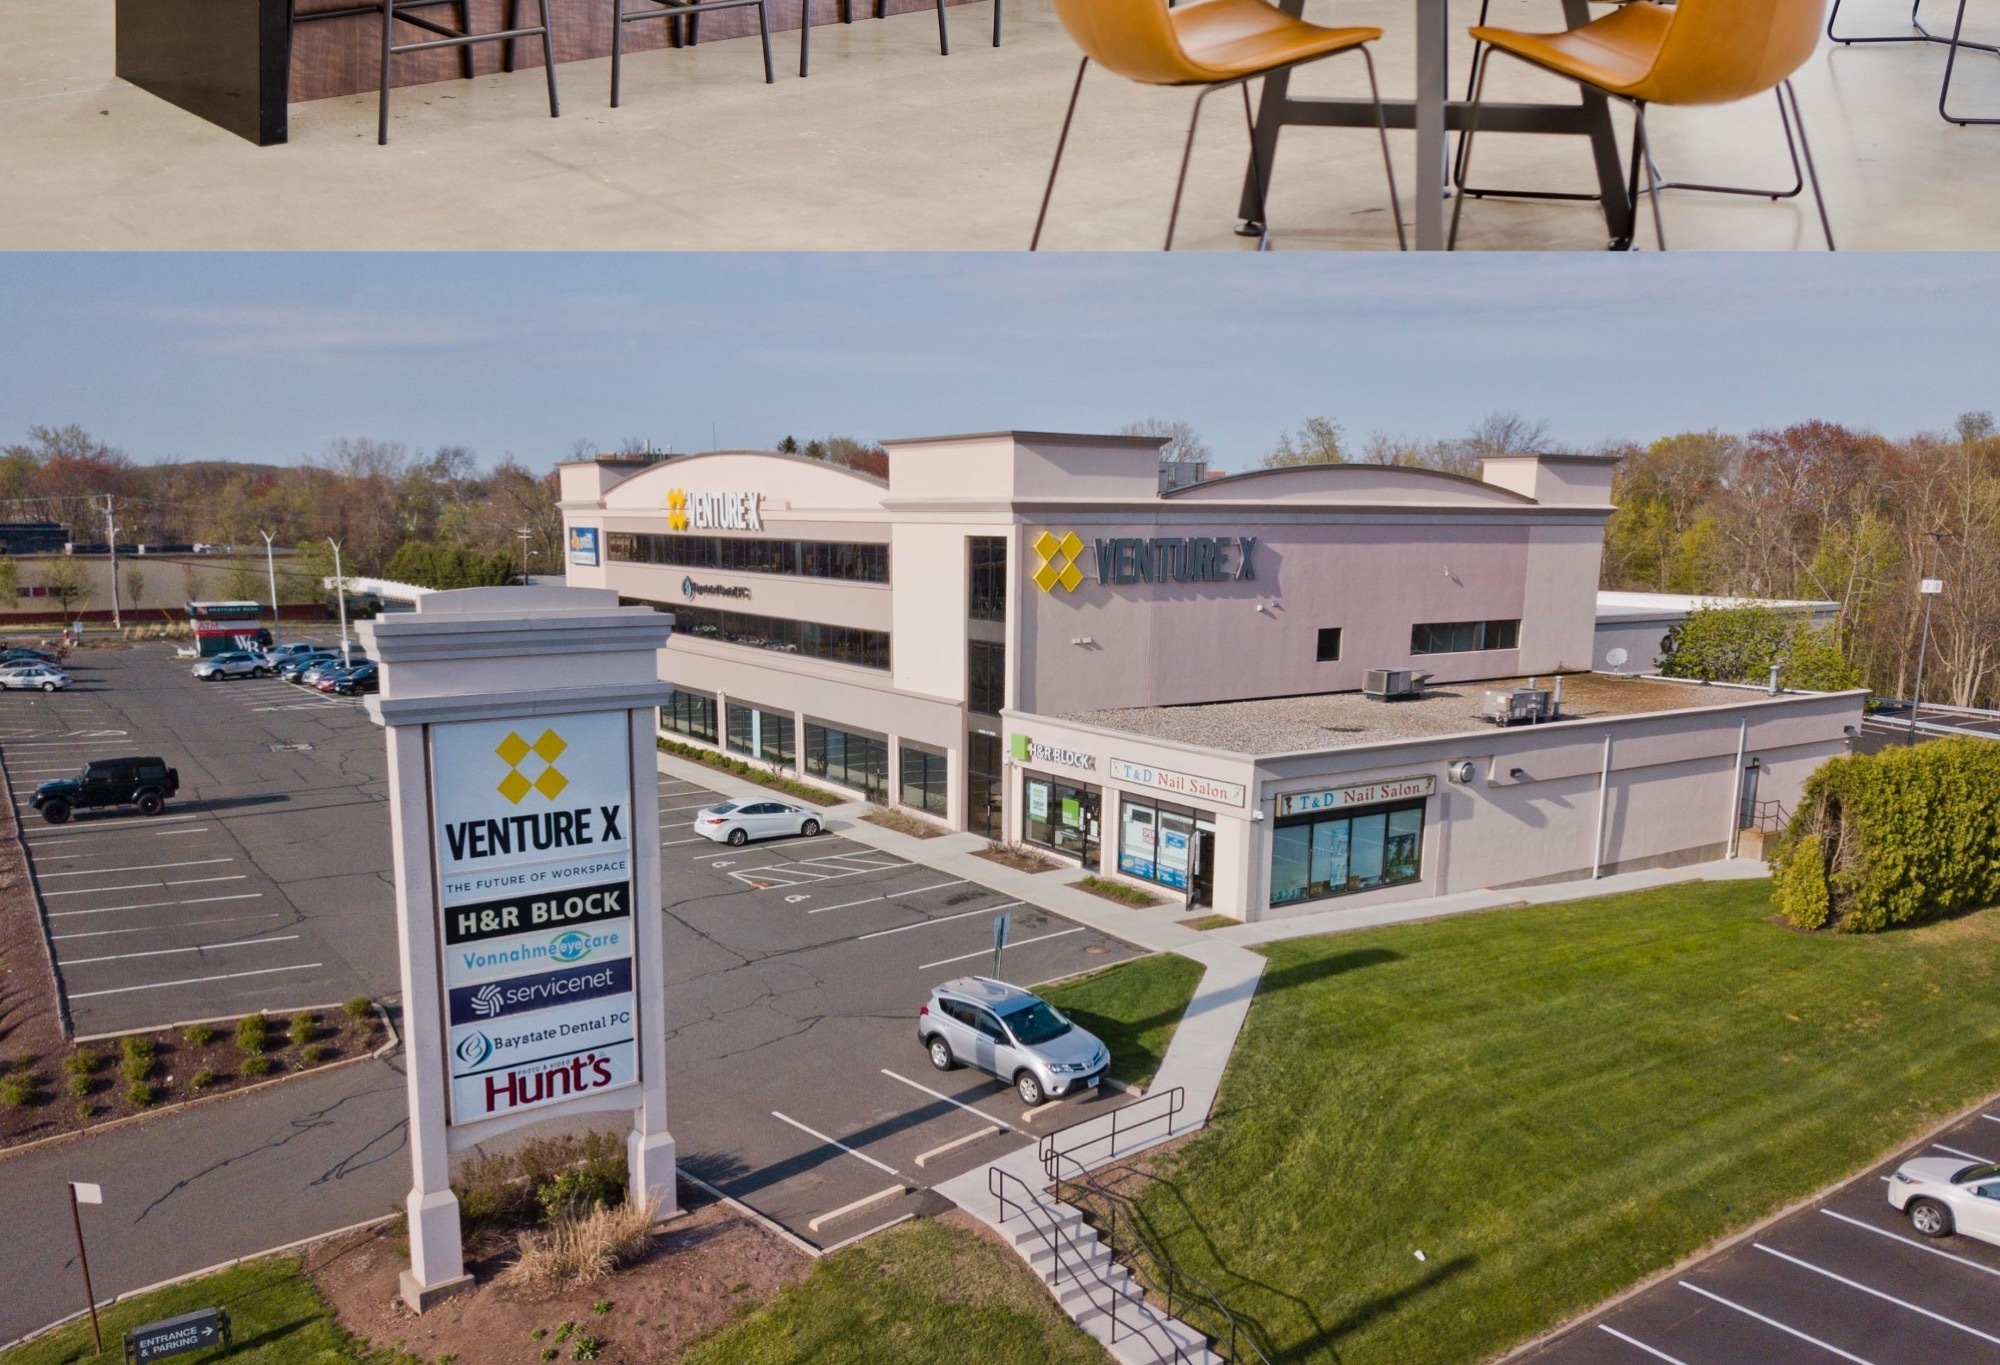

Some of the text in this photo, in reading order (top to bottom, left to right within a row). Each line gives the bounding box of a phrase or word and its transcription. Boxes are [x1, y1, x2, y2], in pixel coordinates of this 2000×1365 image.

[688, 492, 760, 530] VENTURE X
[1093, 536, 1257, 585] VENTURE X
[1029, 744, 1089, 769] H&R BLOCK
[1158, 772, 1184, 790] Nail
[1190, 779, 1228, 799] Salon
[1343, 789, 1375, 804] Nail
[1380, 783, 1421, 798] Salon
[445, 805, 622, 861] VENTURE X
[446, 860, 626, 893] THE FUTURE OF WORKSPACE
[458, 890, 621, 935] H&R BLOCK
[506, 968, 614, 1004] servicenet
[493, 1011, 630, 1050] Baystate Dental PC
[549, 1059, 570, 1069] VIDEO
[485, 1053, 612, 1112] Hunt's
[140, 1326, 198, 1348] ENTRANCE
[141, 1336, 198, 1357] & PARKING
